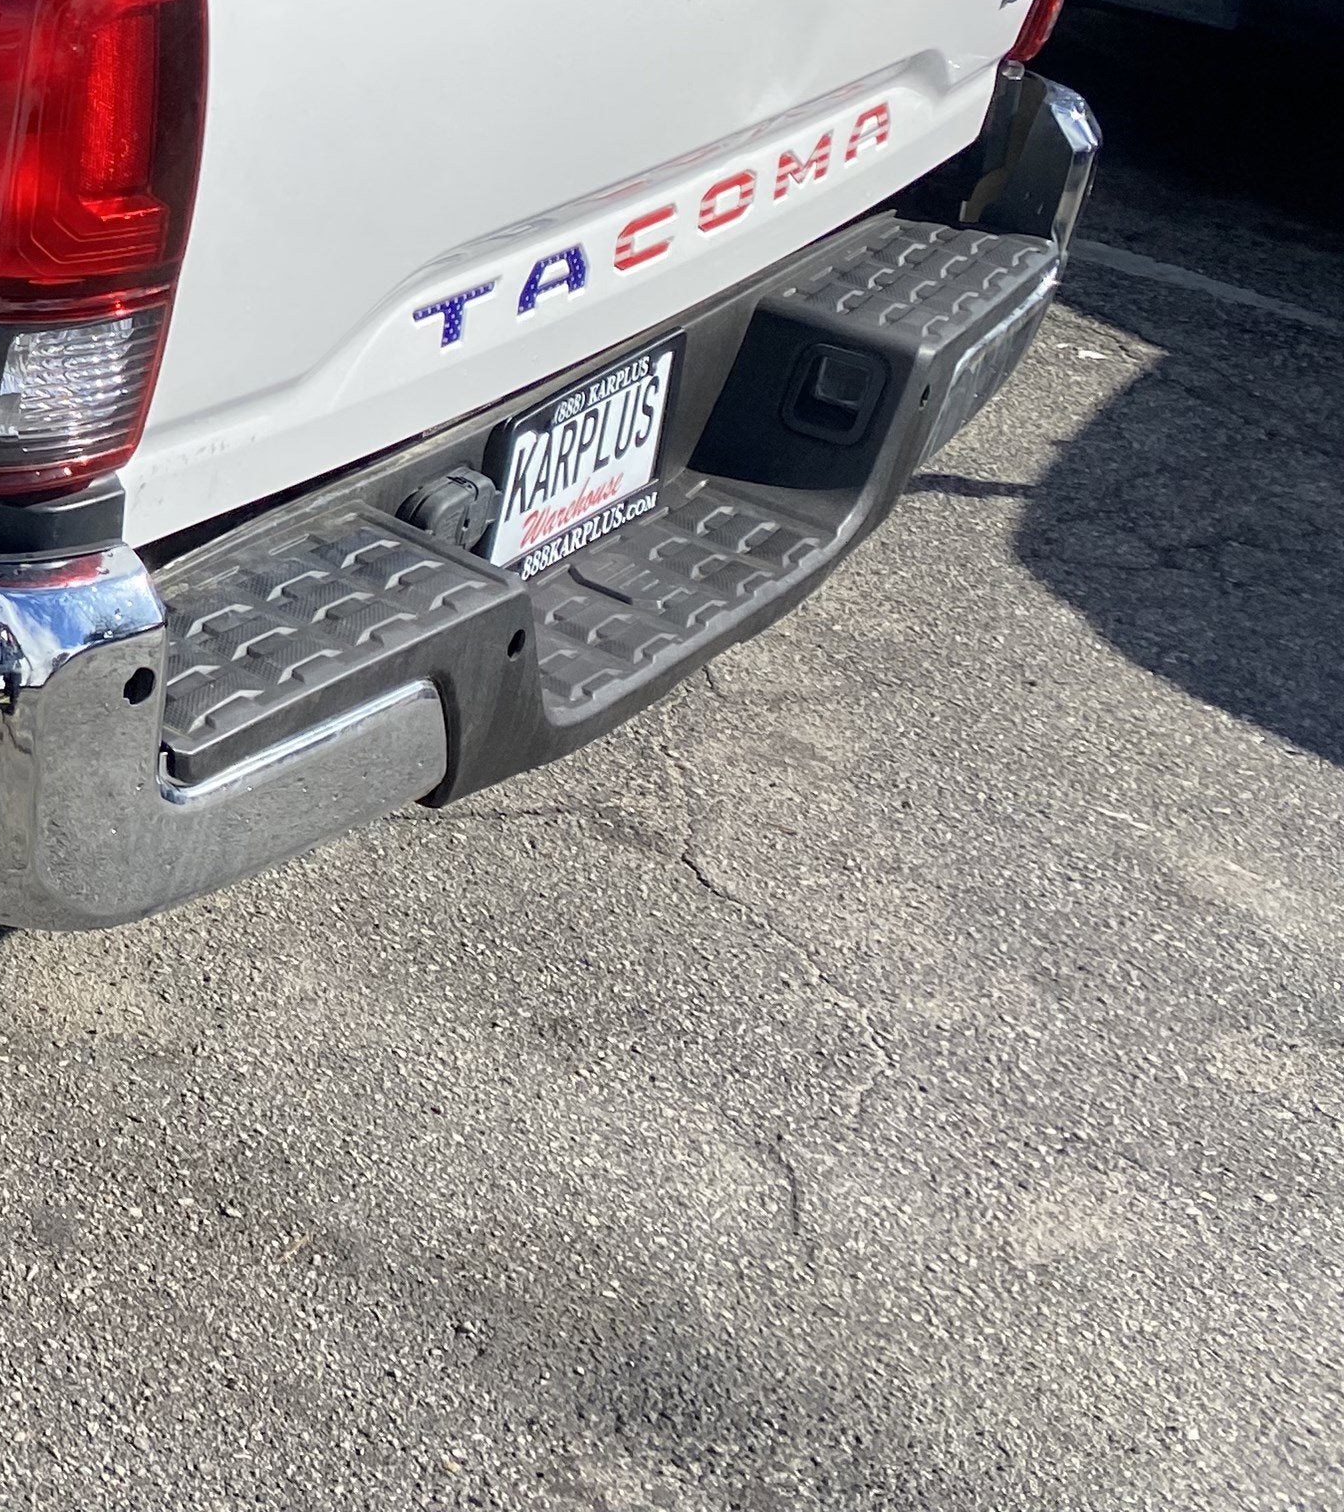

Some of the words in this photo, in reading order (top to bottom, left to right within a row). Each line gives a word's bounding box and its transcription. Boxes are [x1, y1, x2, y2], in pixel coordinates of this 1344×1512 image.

[412, 101, 892, 349] TACOMA
[553, 391, 586, 425] (888)
[587, 355, 651, 405] KARPLUS
[503, 376, 660, 522] KARPLUS
[520, 471, 624, 549] Warehouse
